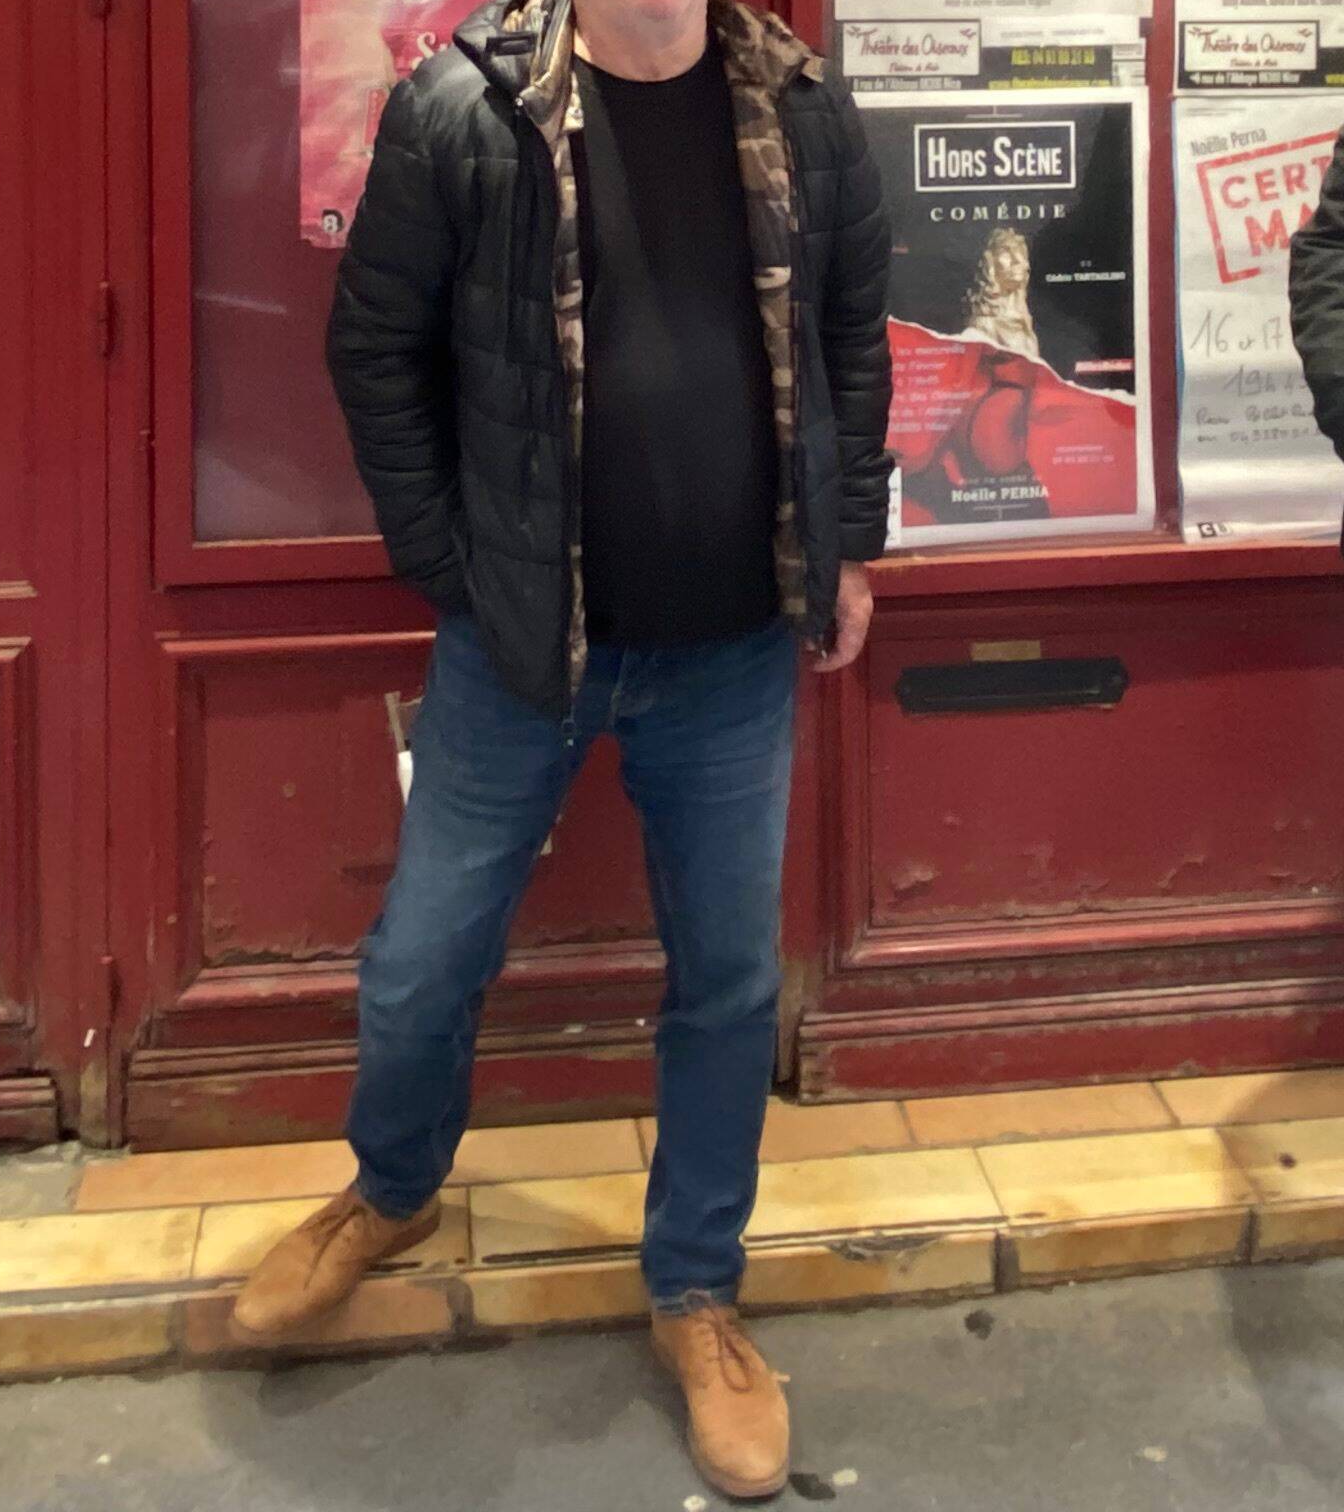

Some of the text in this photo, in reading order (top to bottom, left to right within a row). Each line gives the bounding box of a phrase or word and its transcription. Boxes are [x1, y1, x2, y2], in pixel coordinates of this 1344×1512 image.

[921, 33, 970, 56] Oiseaux
[1260, 33, 1306, 54] Oiseaux
[1190, 127, 1268, 156] Noëlle Perna
[927, 136, 1063, 179] HORS SCÈNE
[1221, 156, 1333, 209] CERT
[930, 202, 1067, 222] COMÉDIE
[1190, 308, 1232, 358] 16
[1261, 316, 1283, 351] 17
[1224, 364, 1309, 398] 19h4
[951, 485, 1051, 503] Noëlle PERNA
